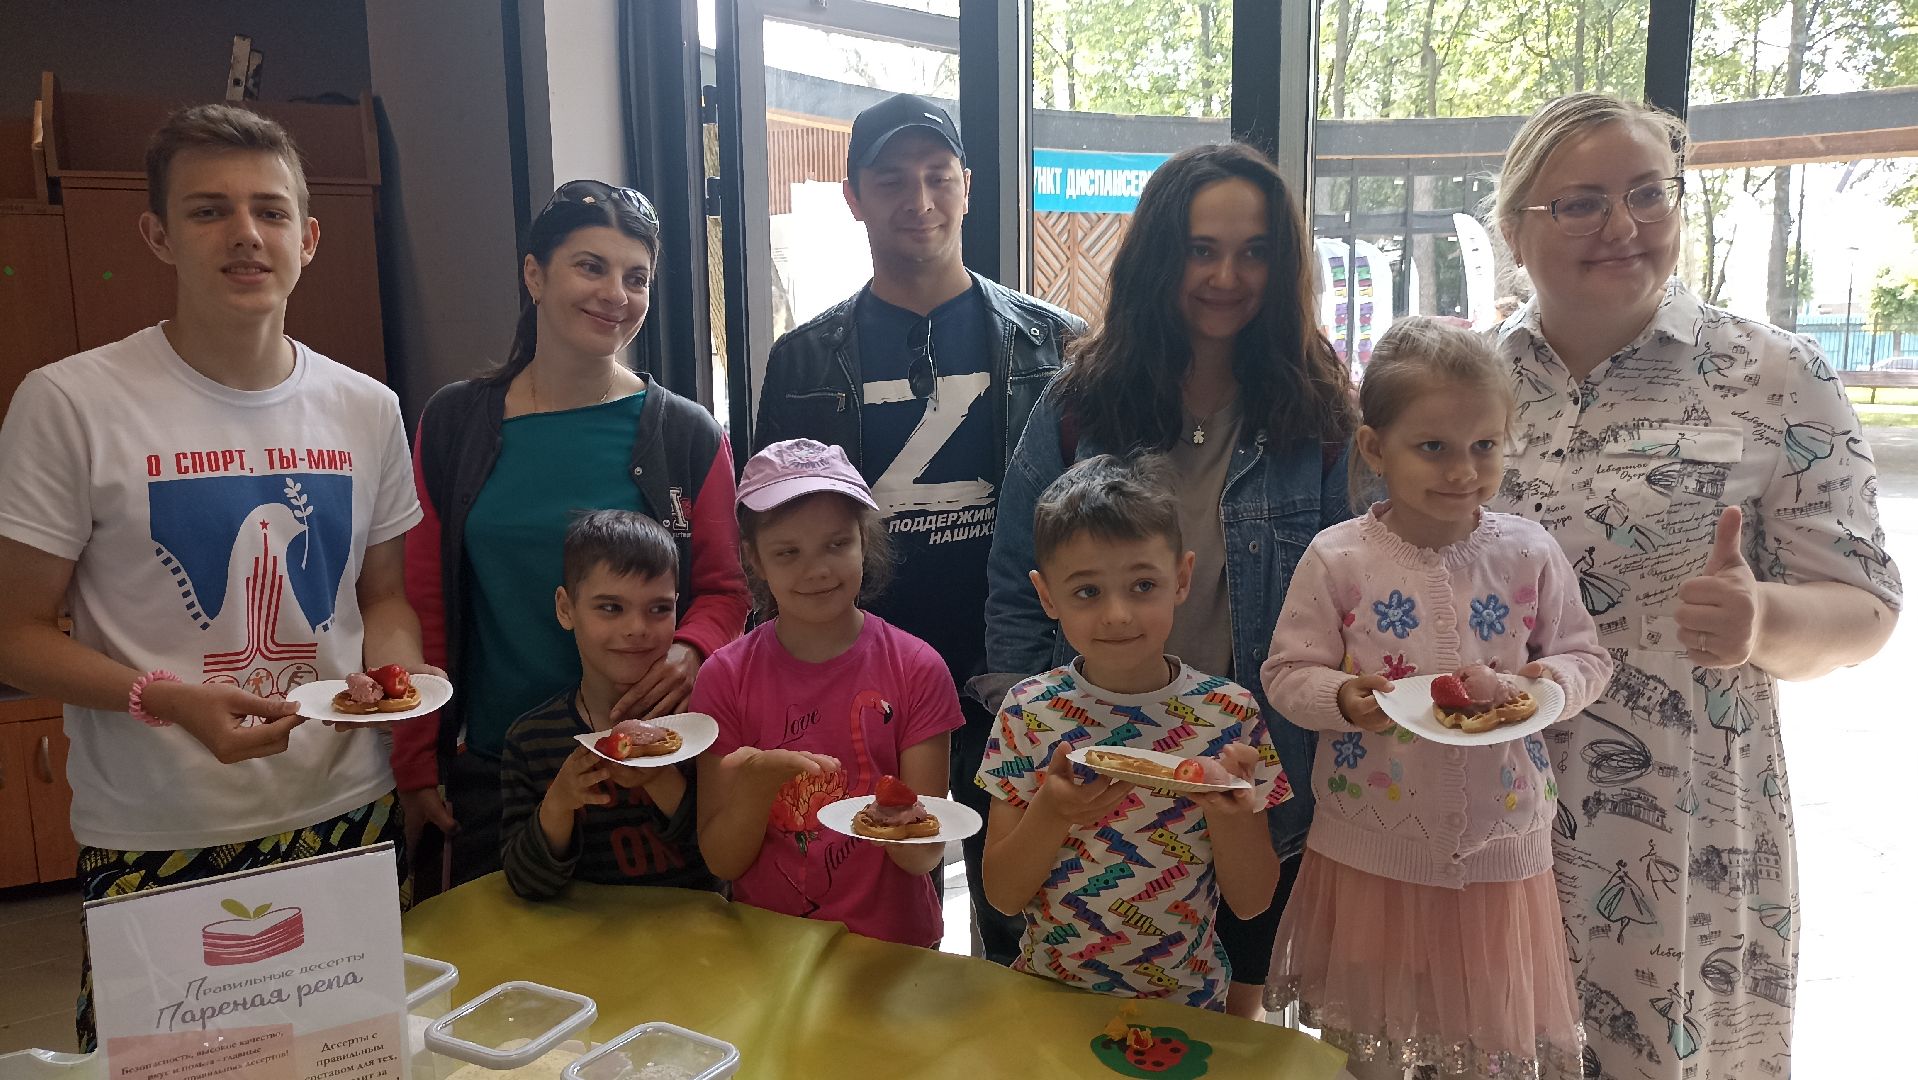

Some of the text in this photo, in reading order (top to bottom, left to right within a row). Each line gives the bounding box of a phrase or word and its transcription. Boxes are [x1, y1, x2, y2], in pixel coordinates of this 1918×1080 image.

[1066, 168, 1153, 200] ДИСПАНСЕР
[146, 453, 162, 477] О
[174, 449, 255, 475] СПОРТ,
[888, 506, 996, 533] ПОДДЕРЖИМ
[928, 521, 995, 545] НАШИХ!
[778, 704, 823, 747] Love
[184, 952, 366, 1001] Правильные десерты
[154, 970, 365, 1032] Пареная репа
[321, 1034, 369, 1053] Десерты
[357, 1060, 375, 1071] для
